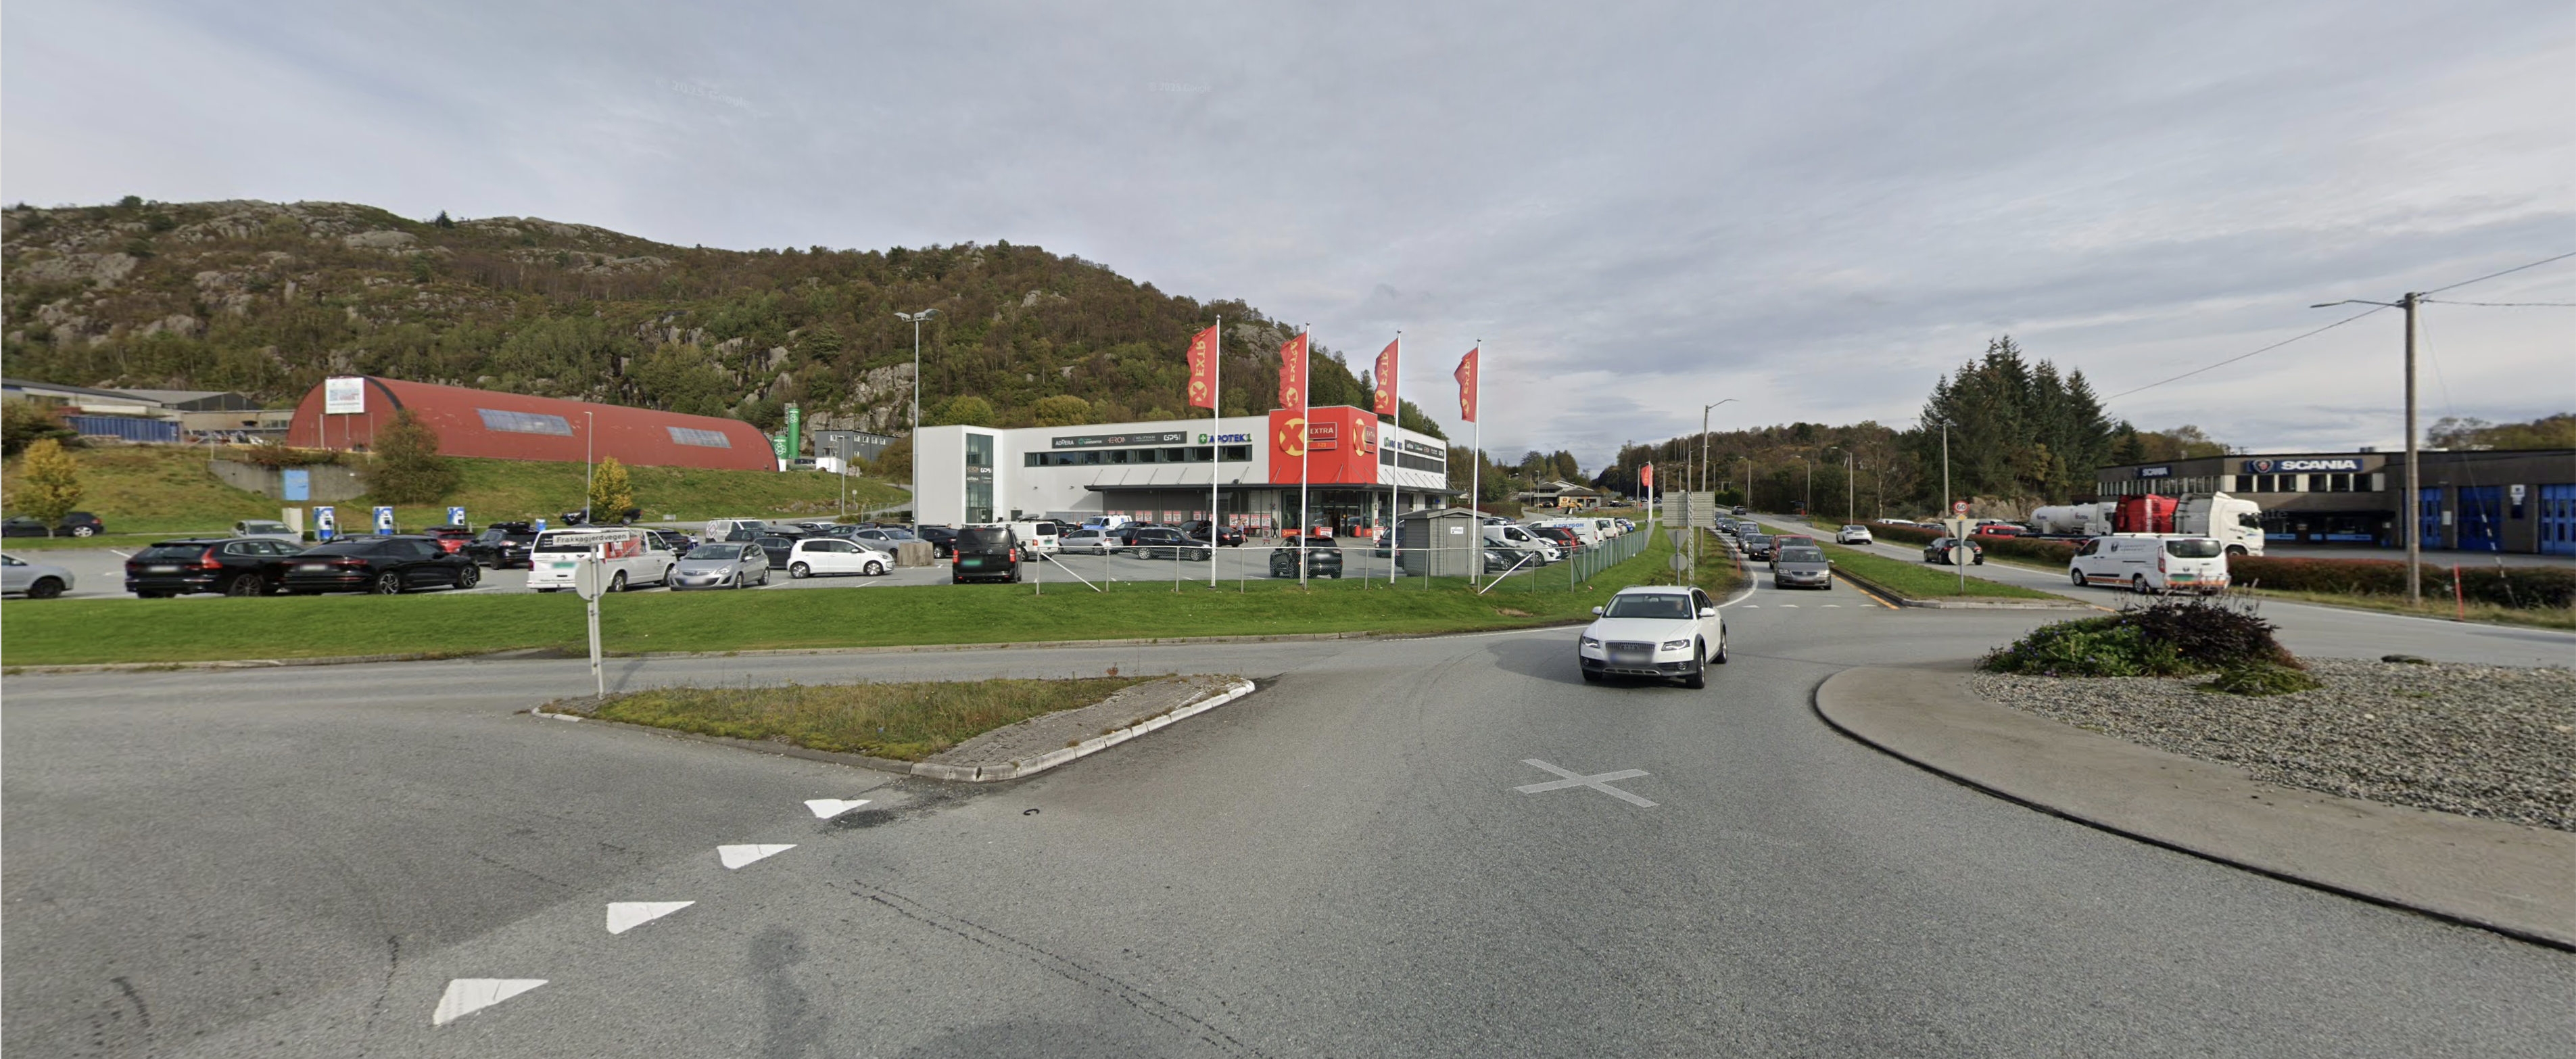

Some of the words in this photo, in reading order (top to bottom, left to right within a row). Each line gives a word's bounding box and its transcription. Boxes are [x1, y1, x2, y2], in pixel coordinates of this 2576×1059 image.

[1209, 433, 1245, 444] APOTEK
[1247, 433, 1252, 442] 1
[2281, 459, 2357, 471] SCANIA
[2142, 467, 2168, 477] SCANIA
[556, 534, 627, 543] Frakkagjerdvegen
